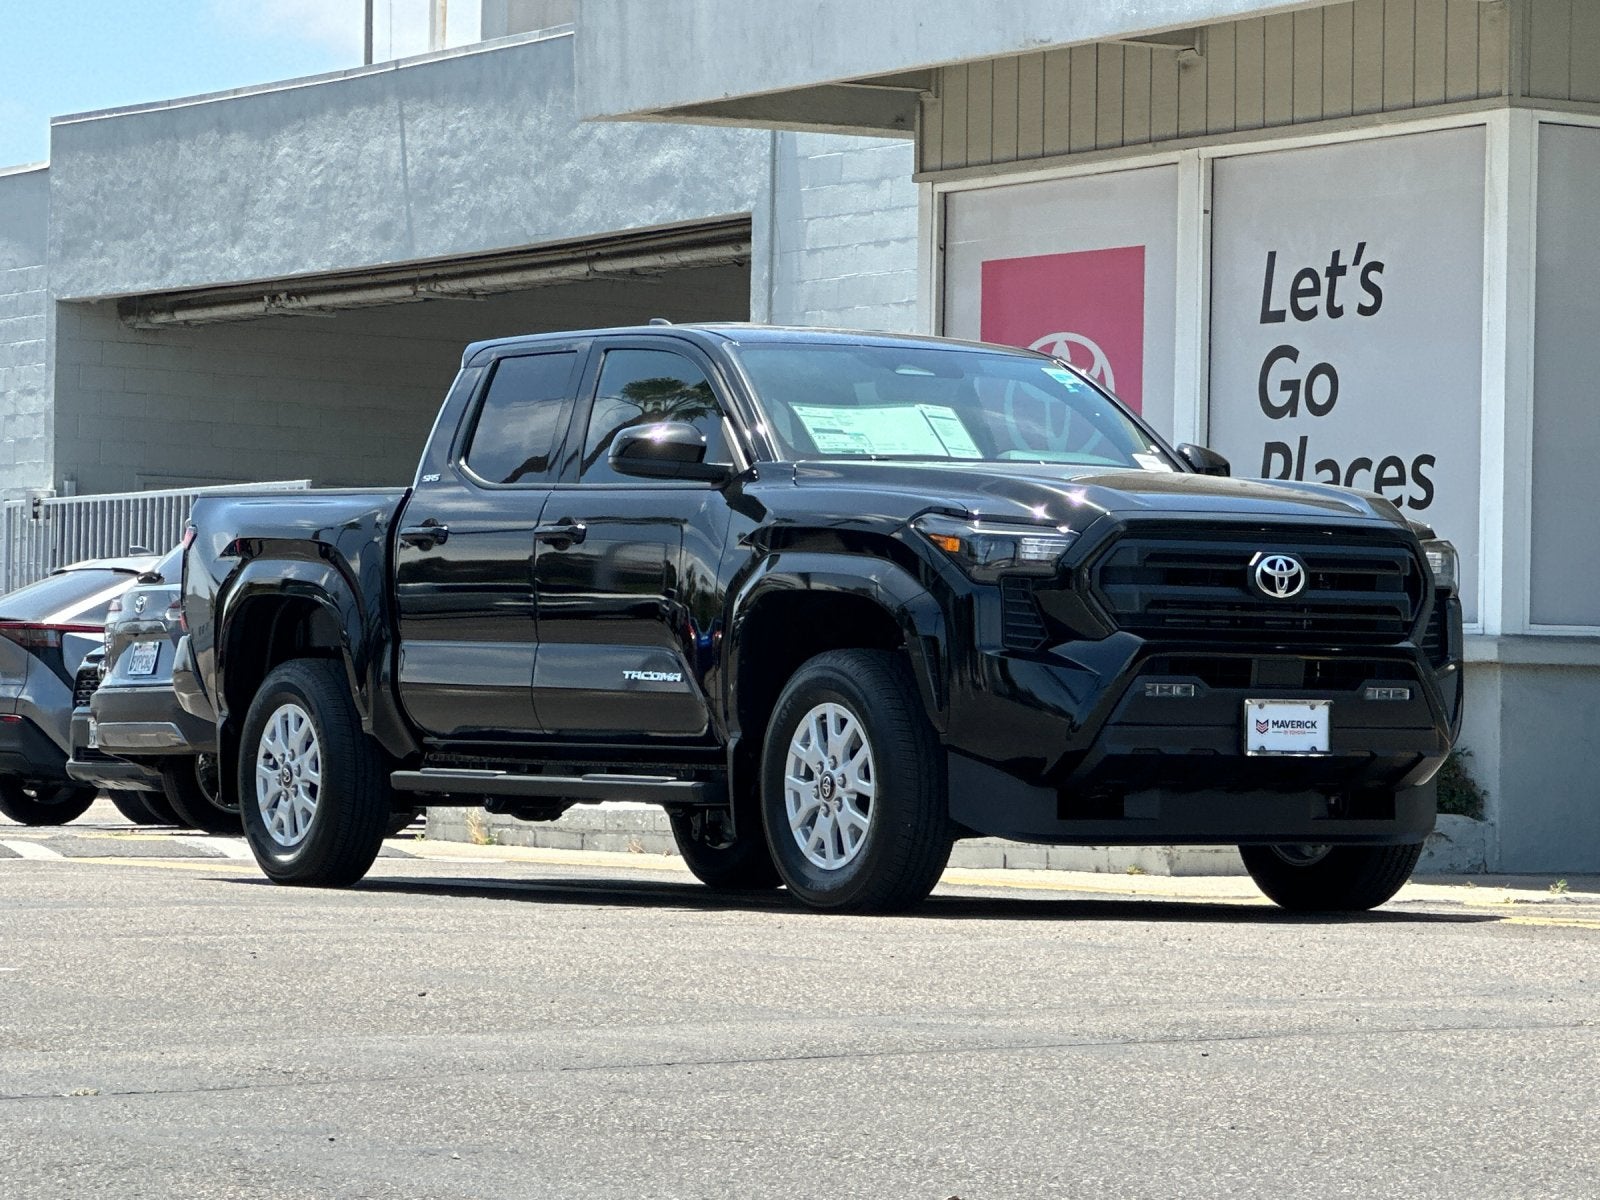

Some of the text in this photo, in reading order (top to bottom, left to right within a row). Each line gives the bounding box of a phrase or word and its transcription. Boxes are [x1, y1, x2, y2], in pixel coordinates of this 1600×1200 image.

[1258, 344, 1339, 420] Go
[622, 670, 682, 682] TACOMA
[1272, 720, 1317, 729] MAVERICK
